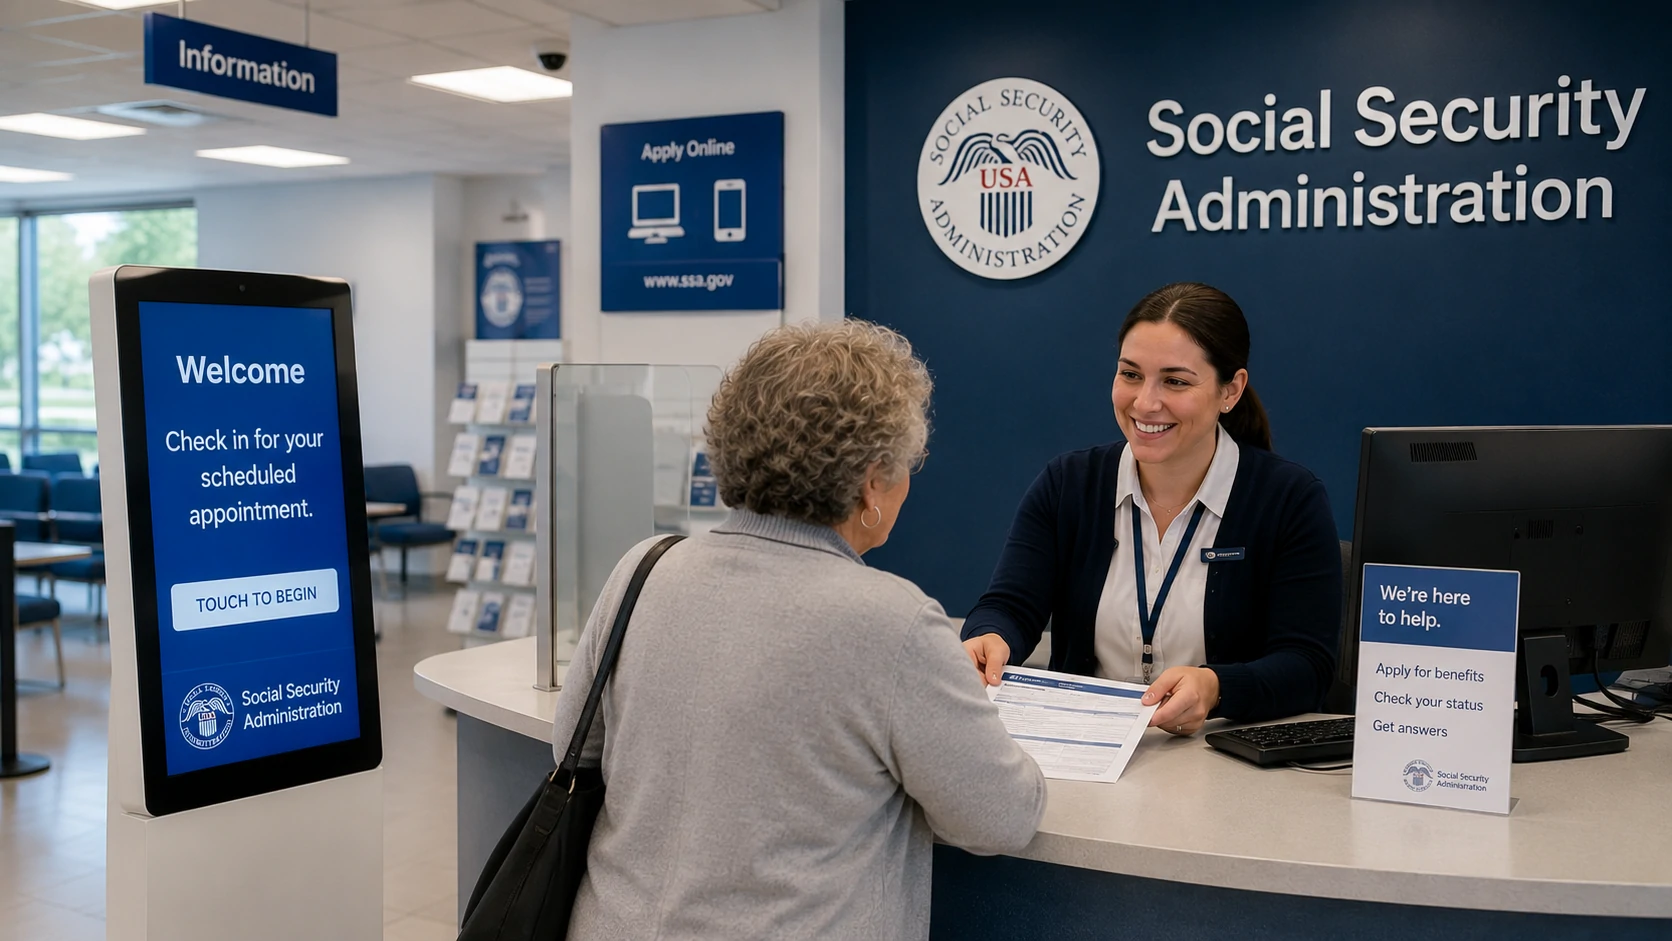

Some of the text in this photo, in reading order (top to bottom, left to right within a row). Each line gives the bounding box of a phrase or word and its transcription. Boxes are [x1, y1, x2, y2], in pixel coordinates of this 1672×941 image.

[179, 39, 315, 93] Information
[930, 89, 1087, 166] SOCIAL SECURITY
[1146, 74, 1647, 157] Social Security
[641, 138, 735, 163] Apply Online
[980, 166, 1034, 190] USA
[1151, 163, 1614, 233] Administration
[930, 193, 1087, 268] ADMINISTRATION
[643, 274, 735, 292] www.ssa.gov
[176, 355, 306, 385] Welcome
[165, 428, 324, 454] Check in for your
[201, 462, 297, 488] scheduled
[189, 499, 313, 530] appointment.
[196, 586, 318, 613] TOUCH TO BEGIN
[1433, 587, 1471, 606] here
[1378, 609, 1441, 631] to help.
[1375, 662, 1485, 683] Apply for benefits
[241, 684, 283, 707] Social
[286, 677, 341, 700] Security
[1374, 691, 1484, 712] Check your status
[243, 701, 343, 730] Administration
[1372, 719, 1448, 738] Get answers
[1437, 770, 1459, 780] Social
